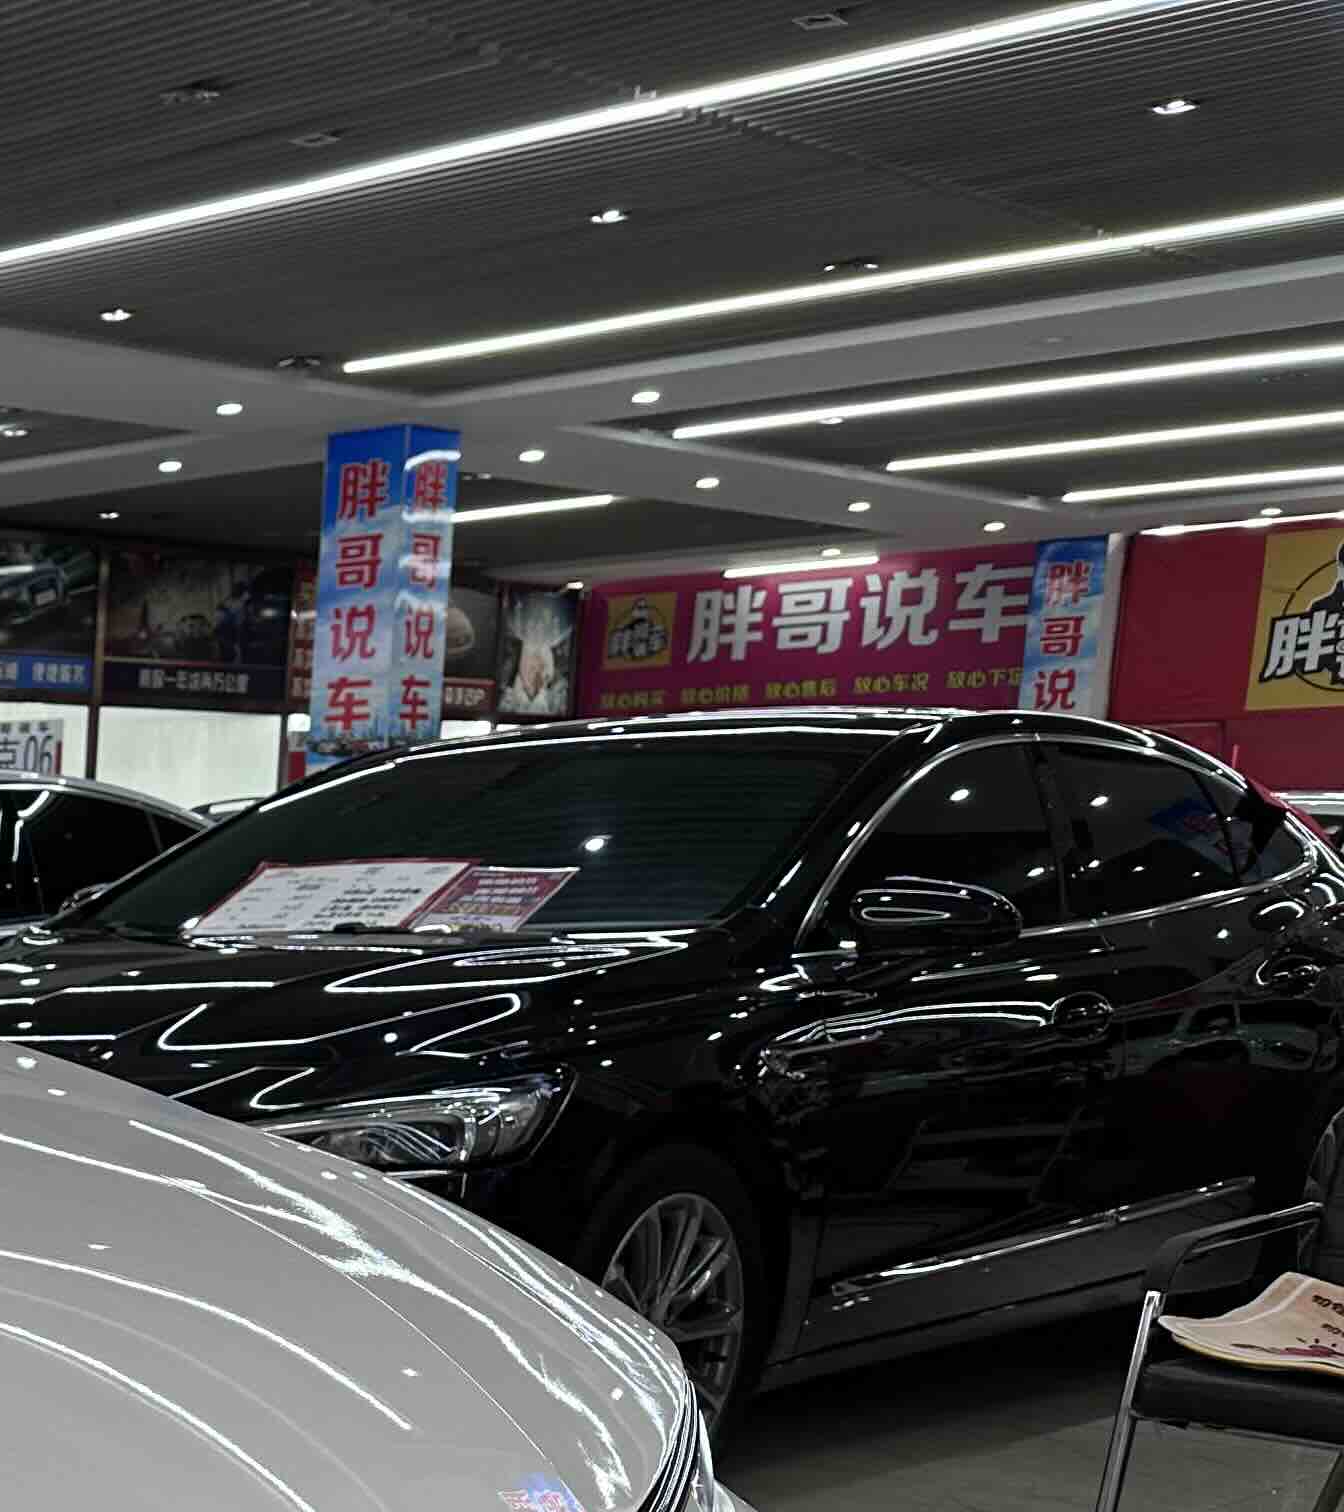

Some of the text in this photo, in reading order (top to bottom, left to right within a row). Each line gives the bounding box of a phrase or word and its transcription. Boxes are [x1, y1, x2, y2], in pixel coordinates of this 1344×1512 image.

[324, 460, 391, 731] 胖哥说车
[399, 463, 448, 730] 胖哥说车
[686, 567, 1034, 664] 胖哥说车
[1033, 560, 1091, 711] 胖哥说
